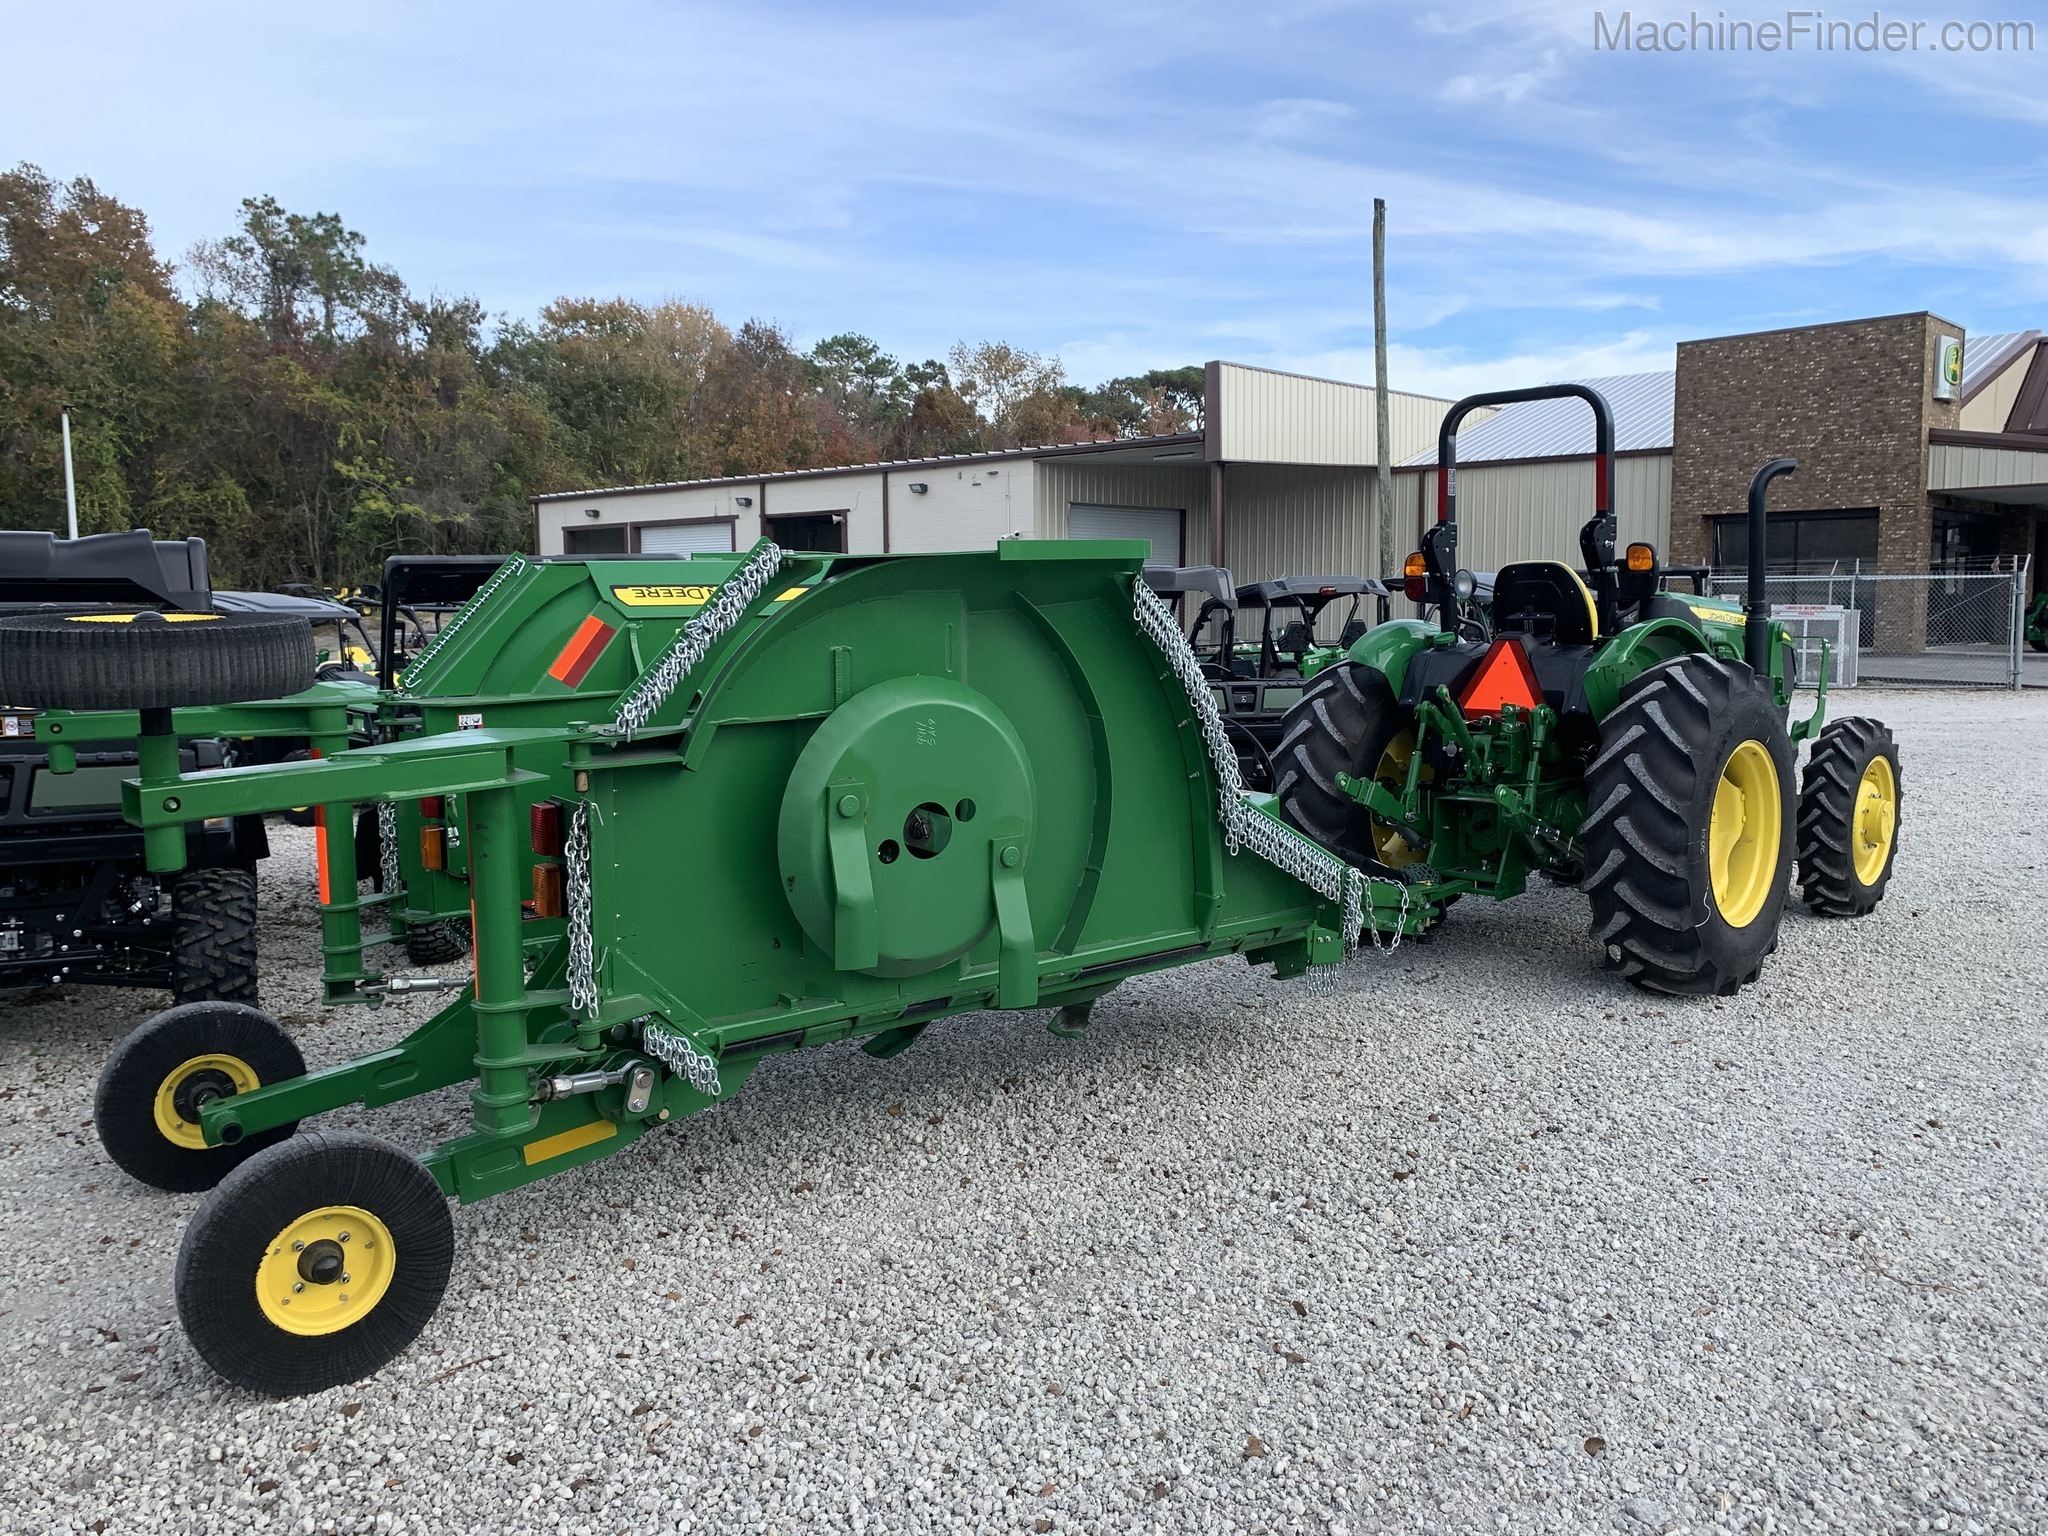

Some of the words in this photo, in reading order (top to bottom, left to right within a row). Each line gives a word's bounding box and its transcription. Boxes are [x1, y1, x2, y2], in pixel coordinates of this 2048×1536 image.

[631, 588, 704, 599] DEERE
[1708, 611, 1726, 621] JOHN
[1726, 614, 1745, 625] DEERE
